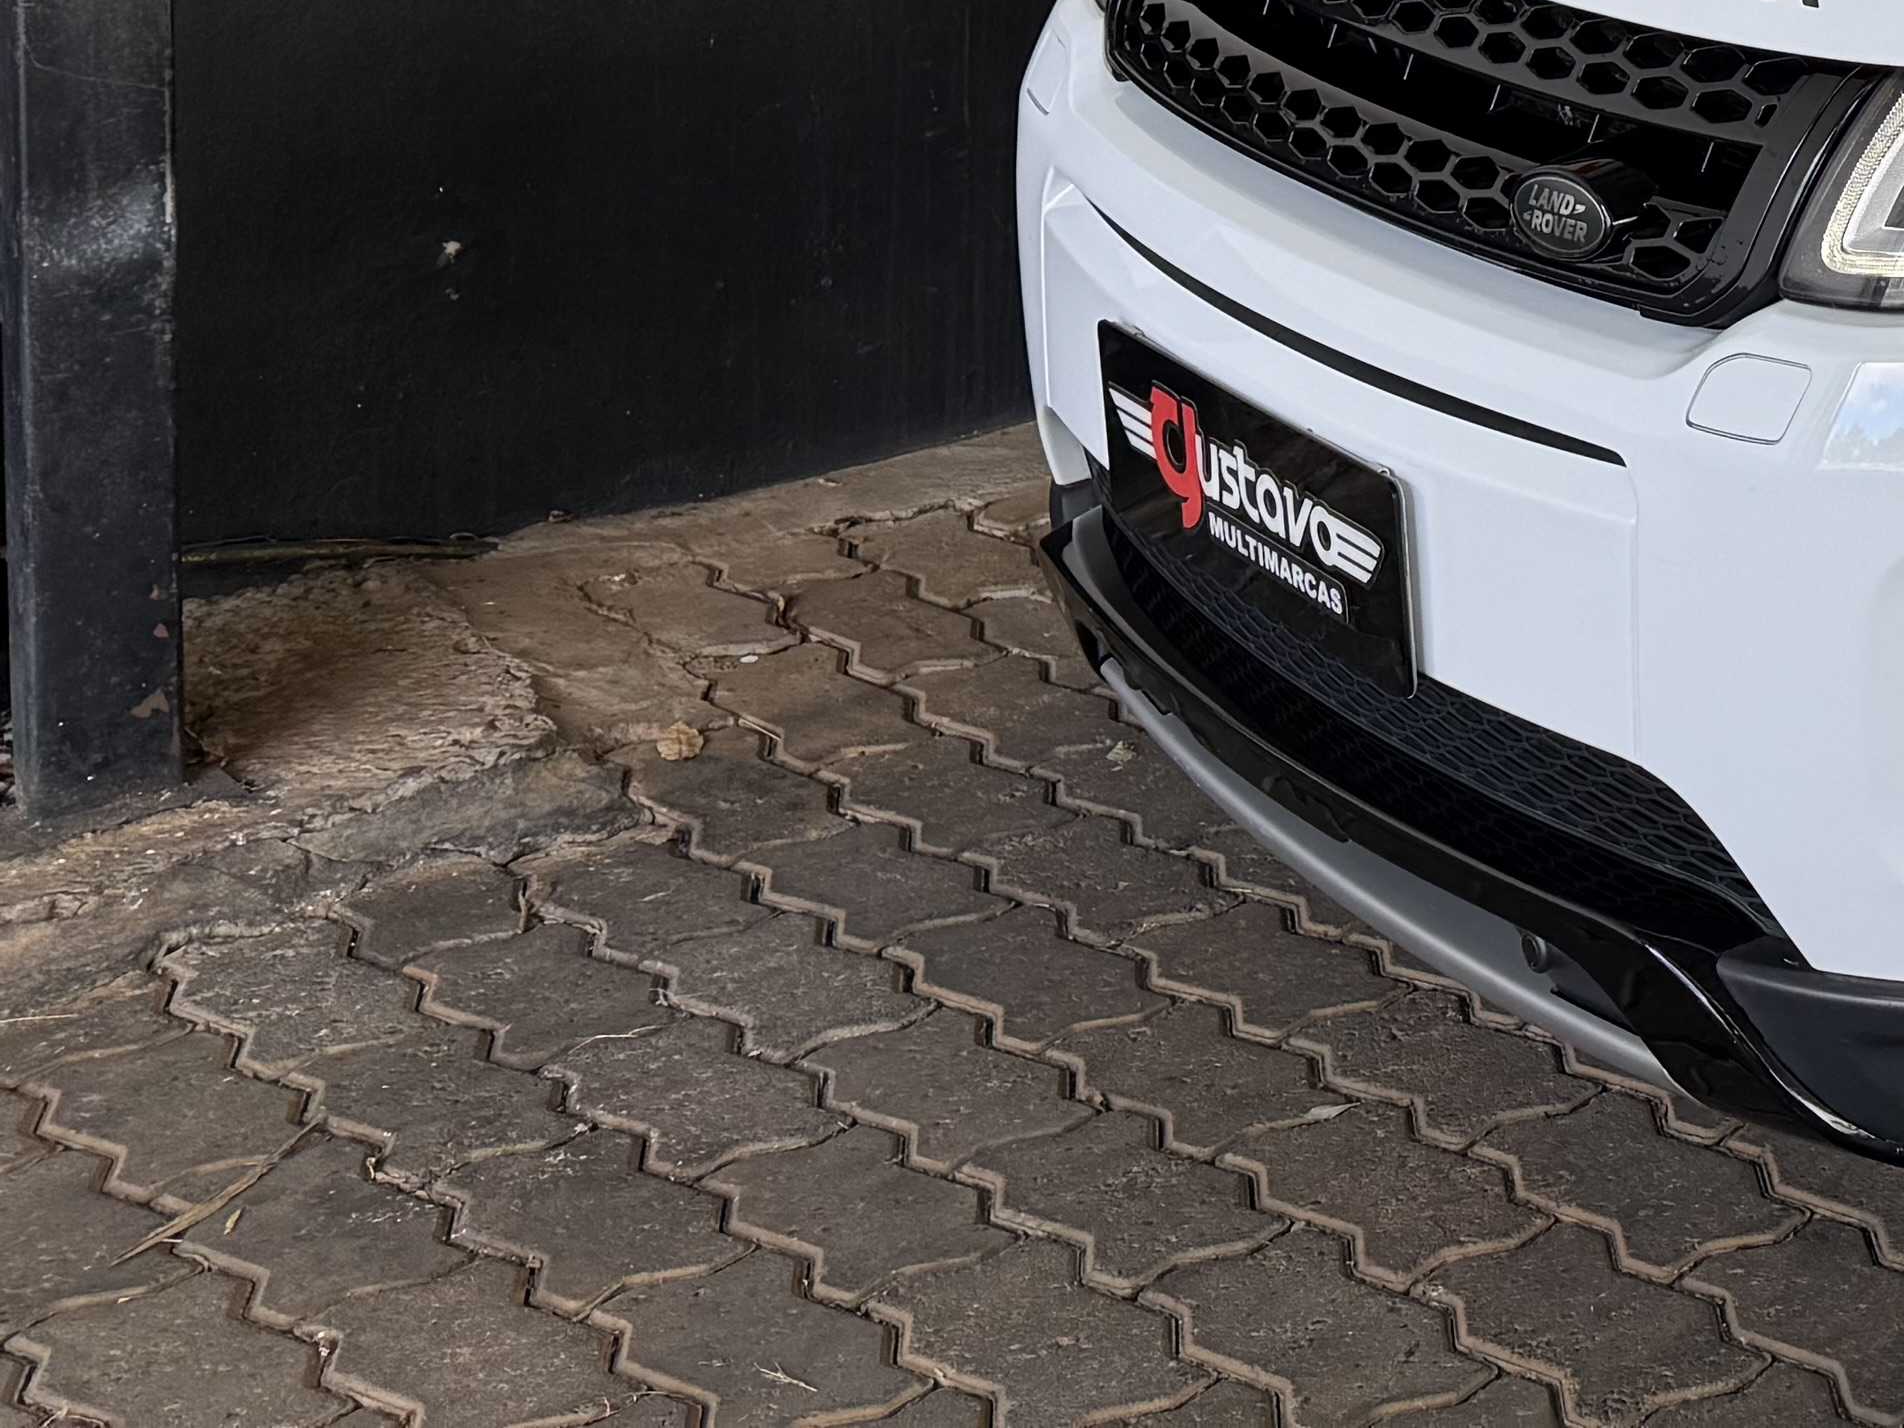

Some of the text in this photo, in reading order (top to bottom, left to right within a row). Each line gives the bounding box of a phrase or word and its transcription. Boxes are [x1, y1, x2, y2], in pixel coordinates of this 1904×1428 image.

[1528, 184, 1575, 216] LAND
[1531, 209, 1588, 243] ROVER
[1151, 386, 1339, 567] gustavo
[1208, 512, 1343, 615] MULTIMARCAS
